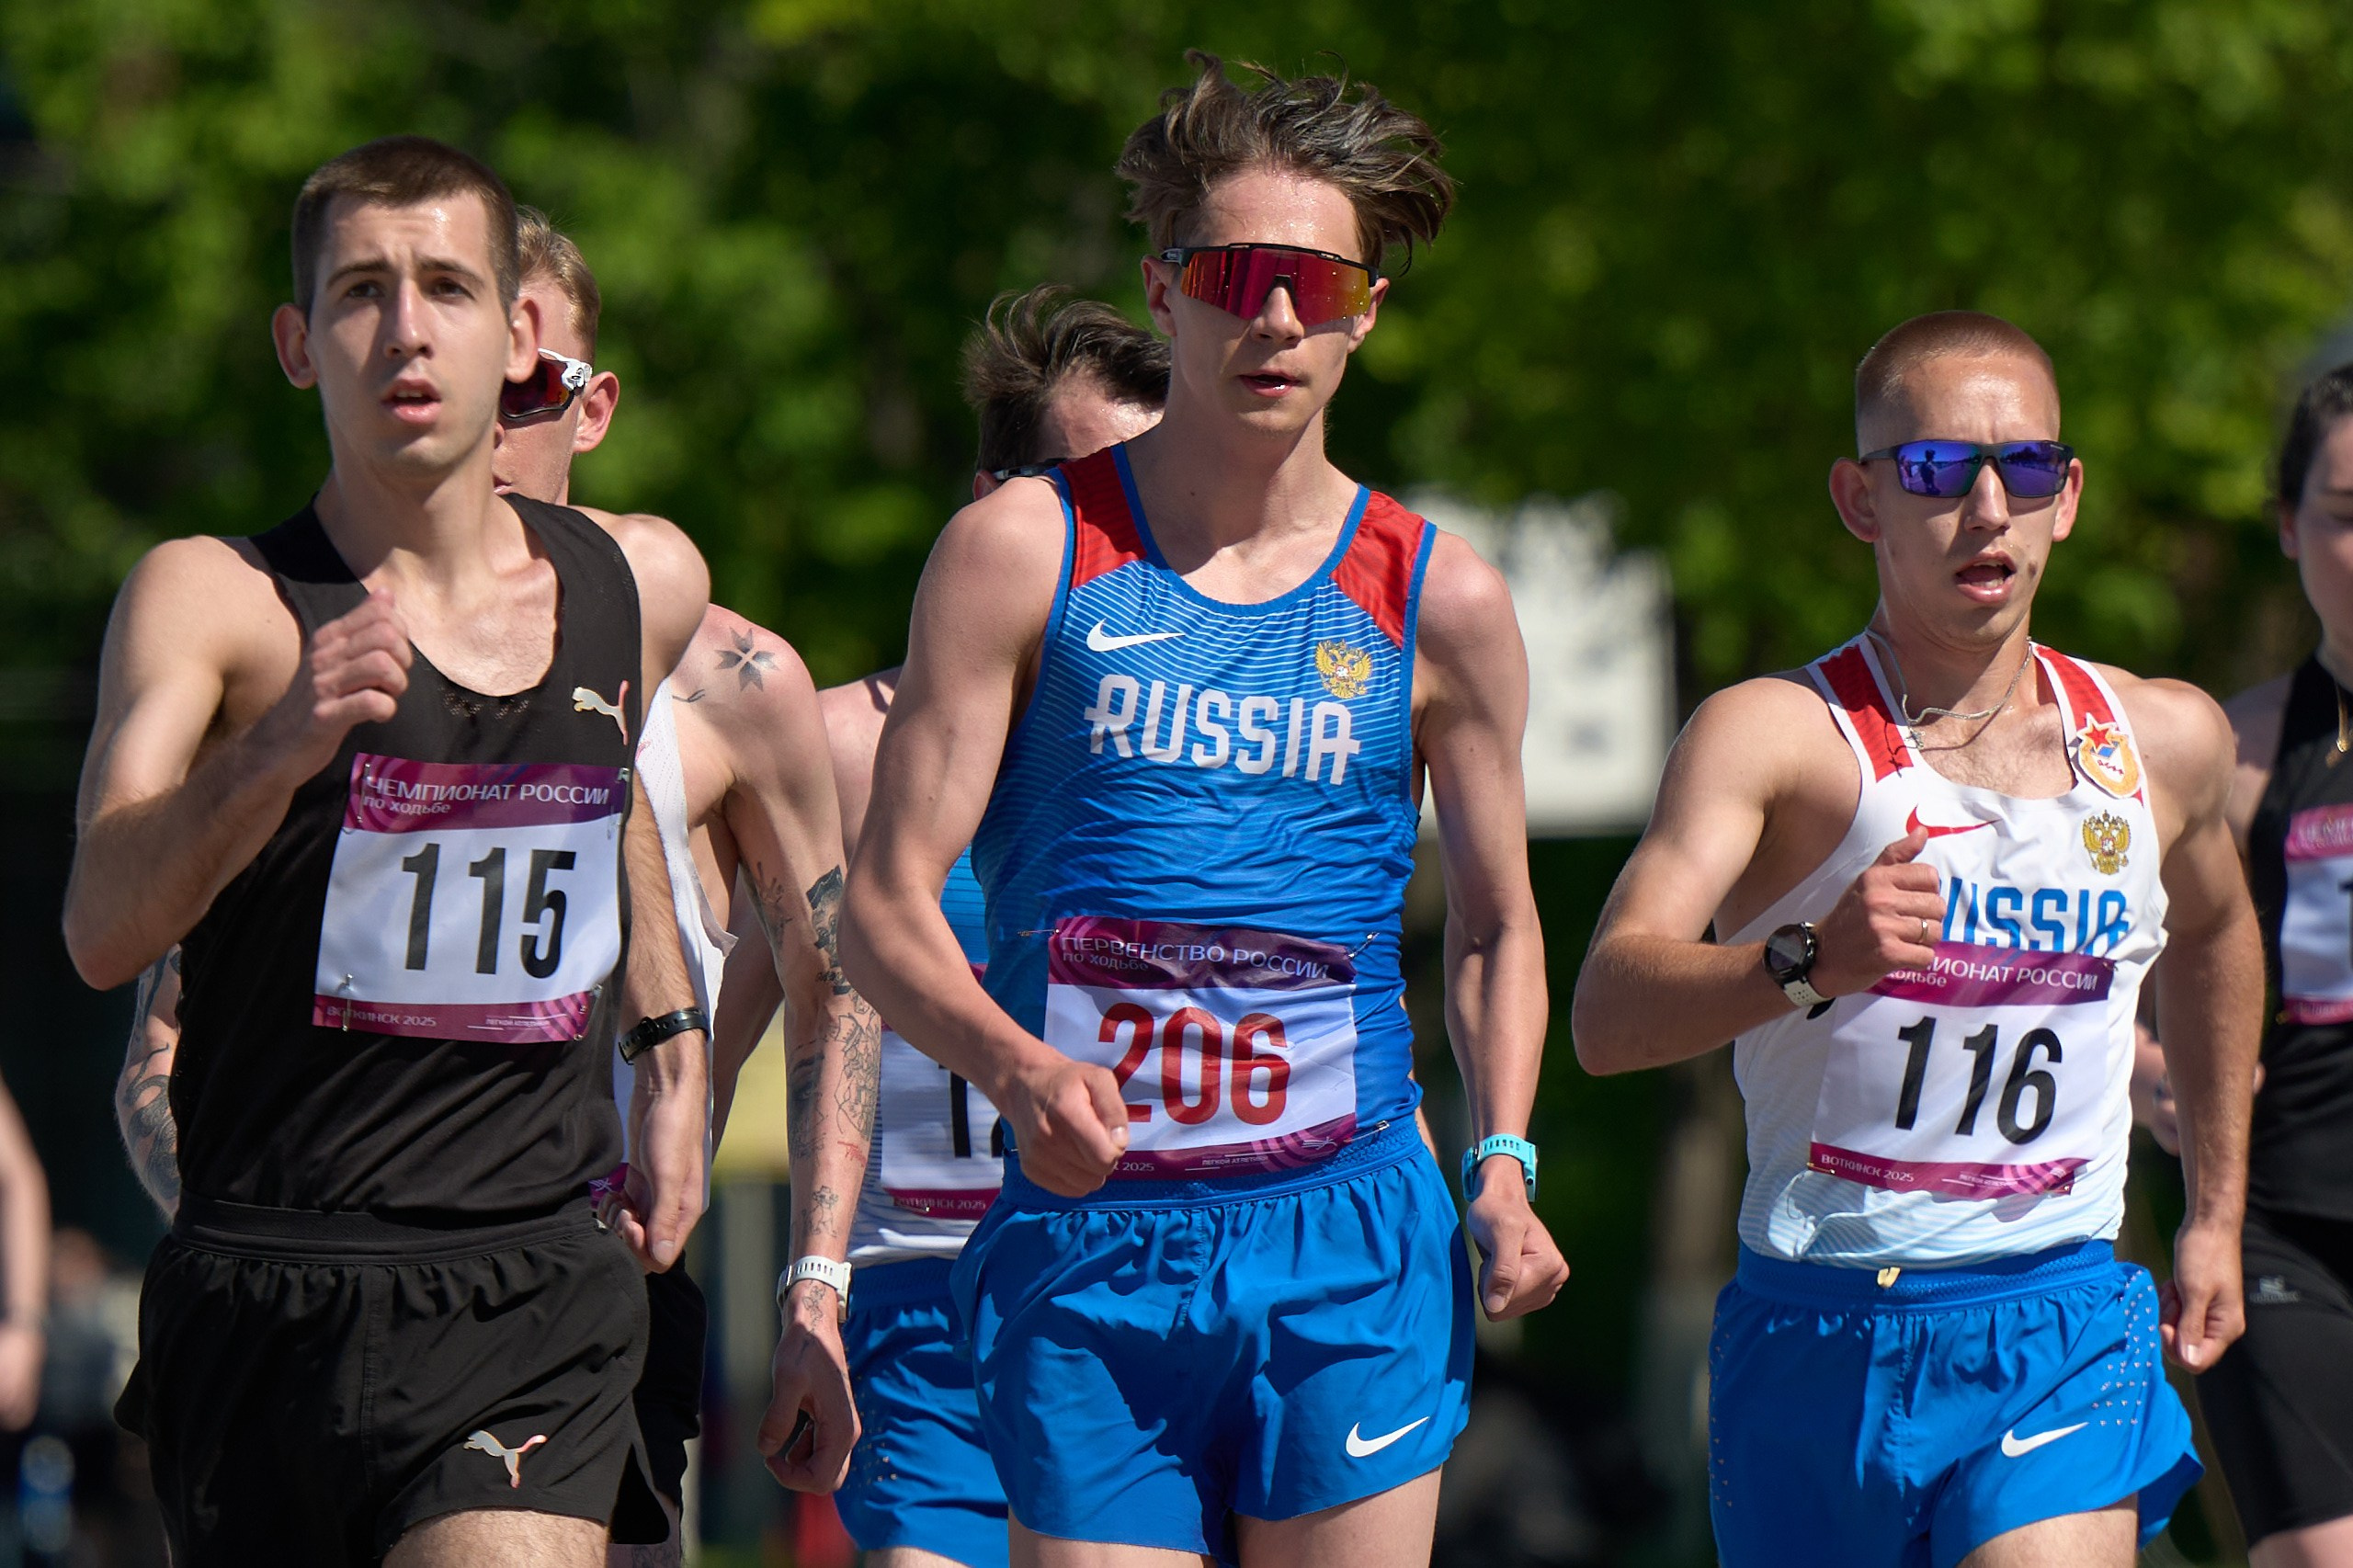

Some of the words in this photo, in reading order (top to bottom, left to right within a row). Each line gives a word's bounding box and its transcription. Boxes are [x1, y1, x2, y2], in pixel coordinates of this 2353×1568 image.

[1084, 674, 1361, 785] RUSSIA
[363, 796, 385, 810] по
[390, 801, 451, 816] ходьбе
[367, 776, 512, 801] ЧЕМПИОНАТ
[519, 784, 610, 806] РОССИИ
[402, 843, 576, 979] 115
[1938, 876, 2130, 959] USSIA
[1060, 937, 1225, 963] ПЕРВЕНСТВО
[1233, 949, 1330, 981] РОССИИ
[1063, 951, 1085, 963] по
[1090, 955, 1148, 971] ходьбе
[1927, 956, 2015, 983] ИОНАТ
[2017, 966, 2098, 992] РОССИИ
[326, 1006, 399, 1024] ВОКИНСК
[403, 1015, 438, 1028] 2025
[1097, 1002, 1291, 1126] 206
[1895, 1016, 2063, 1145] 116
[1122, 1161, 1155, 1172] 2025
[1821, 1153, 1881, 1178] ВОТКИНСК
[1882, 1169, 1915, 1183] 2025
